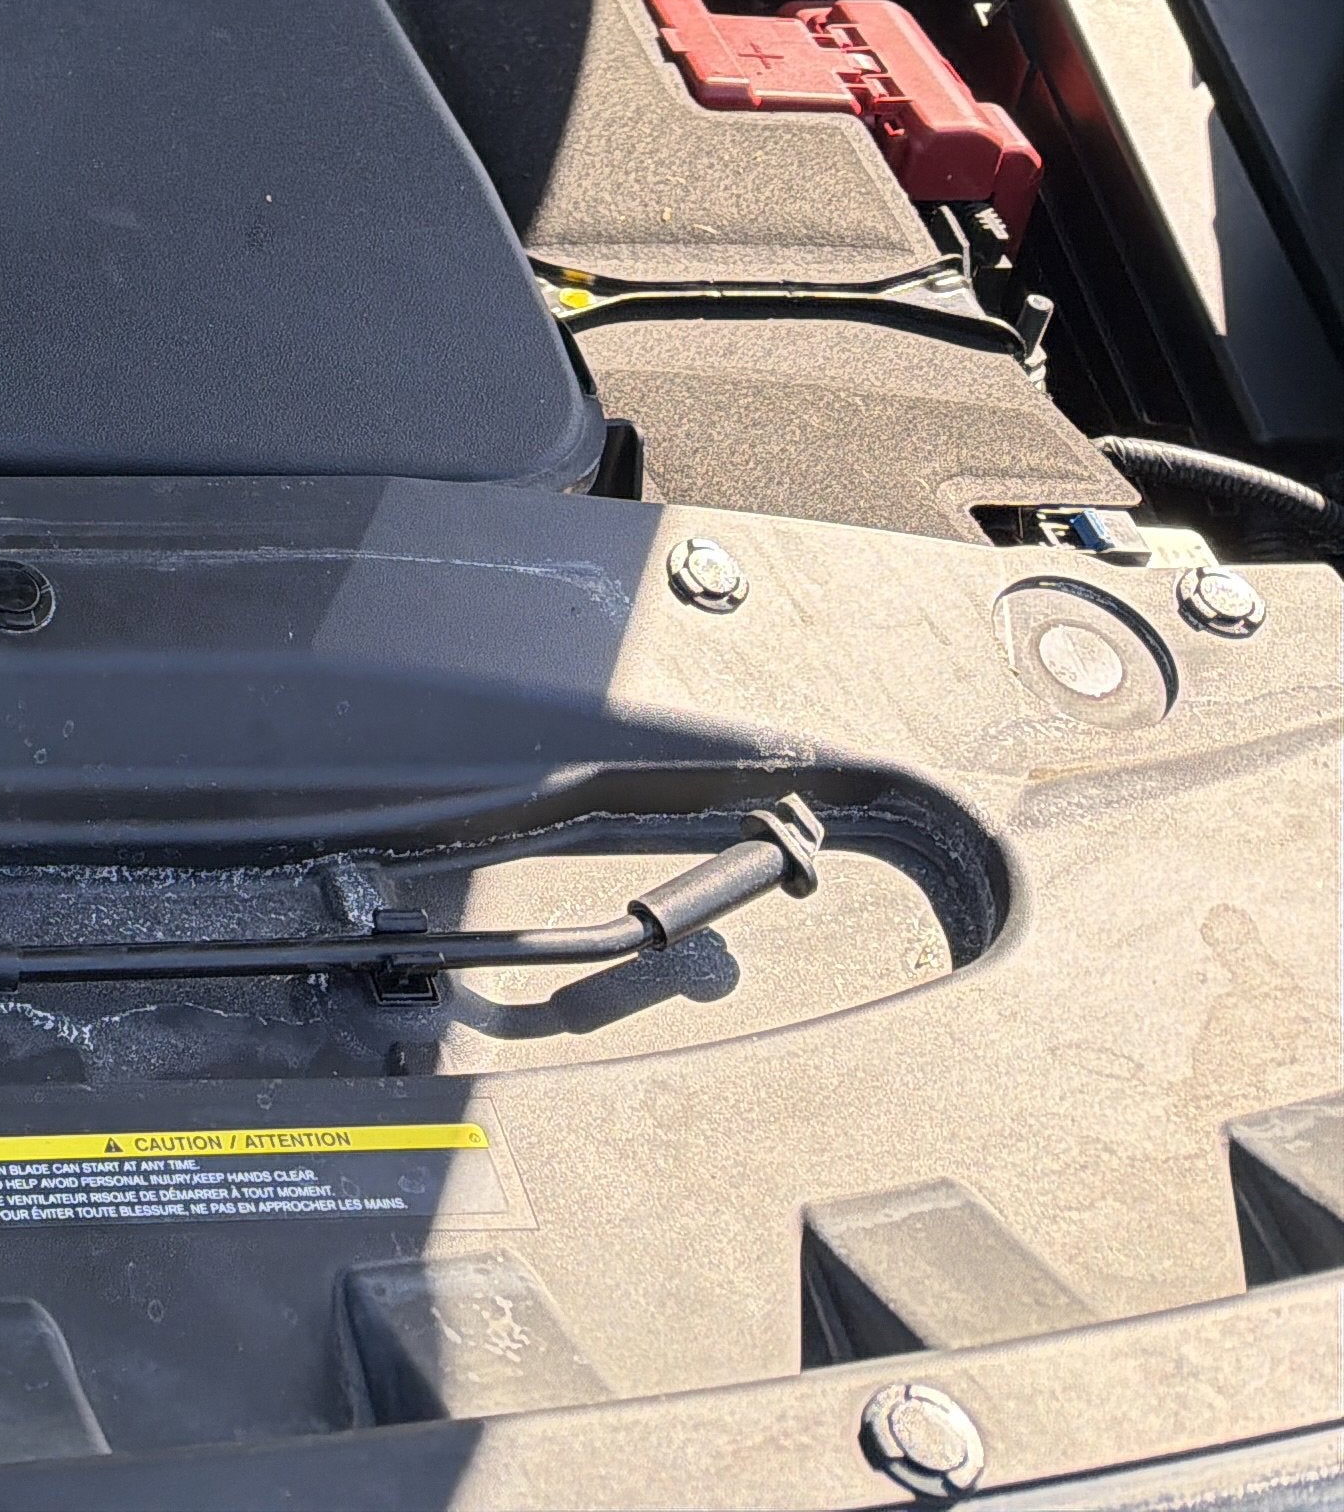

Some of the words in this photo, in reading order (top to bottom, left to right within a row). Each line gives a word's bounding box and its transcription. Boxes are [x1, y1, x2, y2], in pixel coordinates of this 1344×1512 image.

[134, 1135, 223, 1152] CAUTION
[245, 1131, 352, 1149] ATTENTION
[9, 1163, 50, 1176] BLADE
[52, 1163, 81, 1175] CAN
[82, 1162, 120, 1174] START
[123, 1161, 138, 1172] AT
[140, 1160, 165, 1172] ANY
[167, 1159, 200, 1171] TIME.
[5, 1178, 39, 1190] HELP
[40, 1177, 79, 1189] AVOID
[81, 1175, 149, 1188] PERSONAL
[227, 1171, 272, 1183] HANDS
[274, 1169, 318, 1182] CLEAR.
[6, 1192, 88, 1206] VENTILATEUR
[90, 1191, 138, 1204] RISQUE
[139, 1190, 158, 1202] DE
[161, 1187, 229, 1201] DÉMARRER
[231, 1185, 241, 1199] À
[242, 1186, 275, 1199] TOUT
[278, 1185, 336, 1198] MOMENT.
[31, 1206, 75, 1220] ÉVITER
[76, 1206, 118, 1218] TOUTE
[190, 1203, 209, 1215] NE
[210, 1202, 236, 1214] PAS
[238, 1201, 256, 1214] EN
[258, 1199, 338, 1213] APPROCHER
[340, 1198, 363, 1211] LES
[364, 1197, 408, 1210] MAINS.
